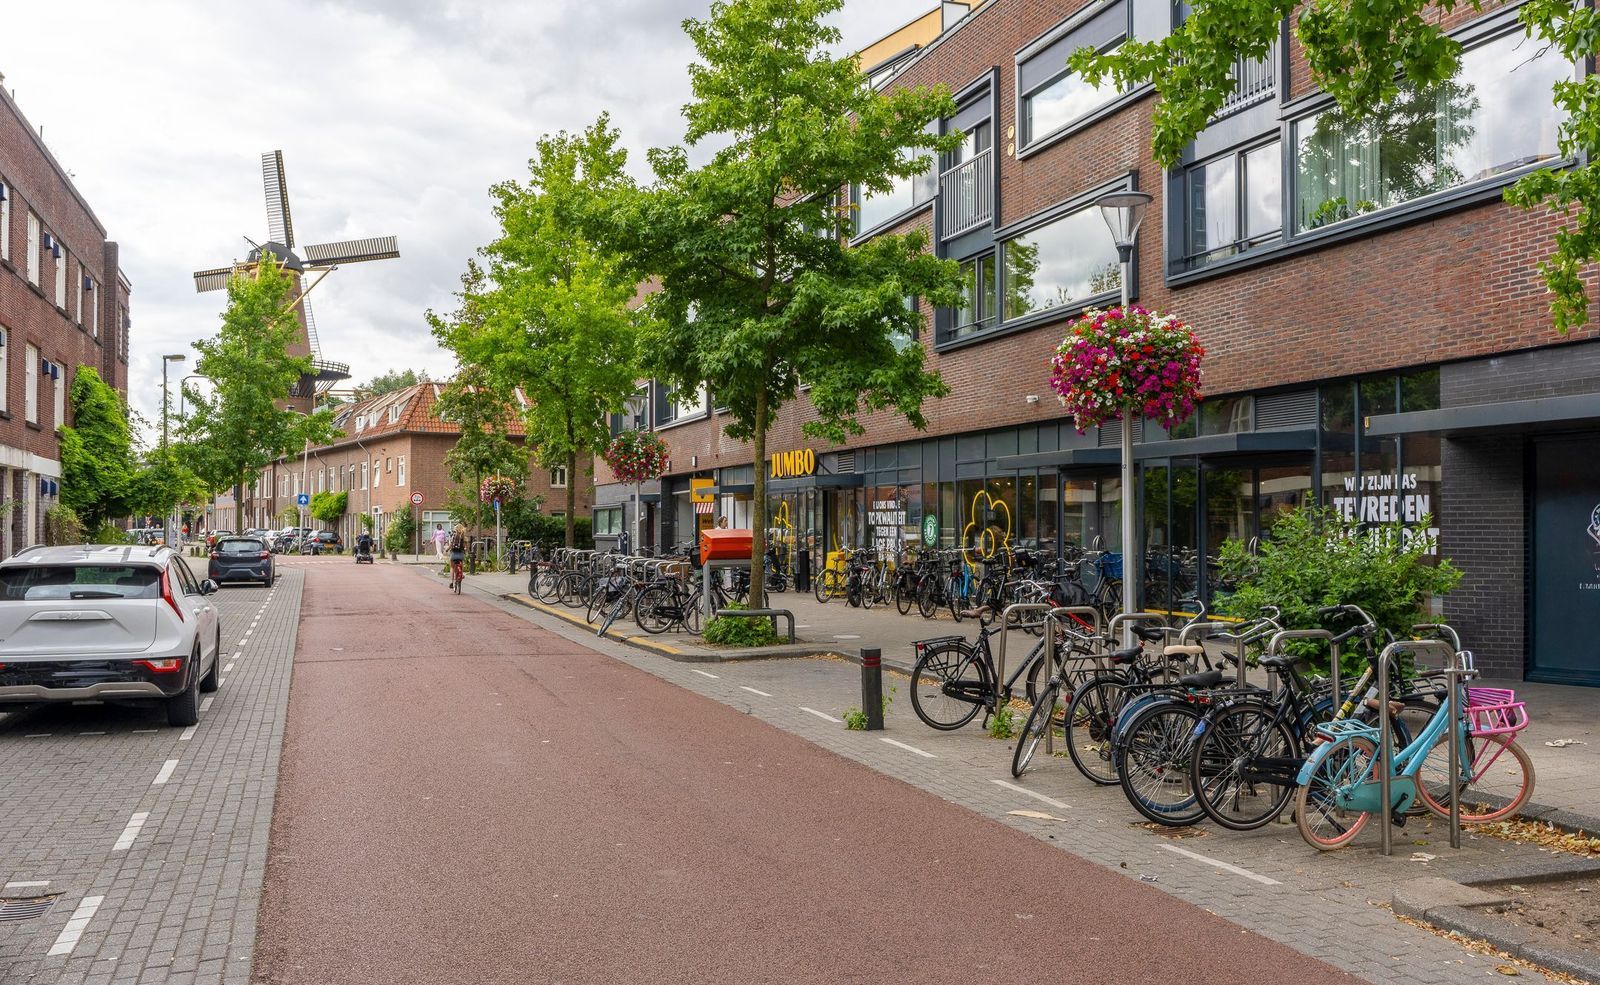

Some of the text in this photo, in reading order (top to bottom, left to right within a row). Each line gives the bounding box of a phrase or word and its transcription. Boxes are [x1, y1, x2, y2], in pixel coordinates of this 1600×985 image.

[770, 448, 815, 478] JUMBO
[1367, 474, 1391, 490] ZIJN
[1333, 495, 1430, 522] TEVREDEN
